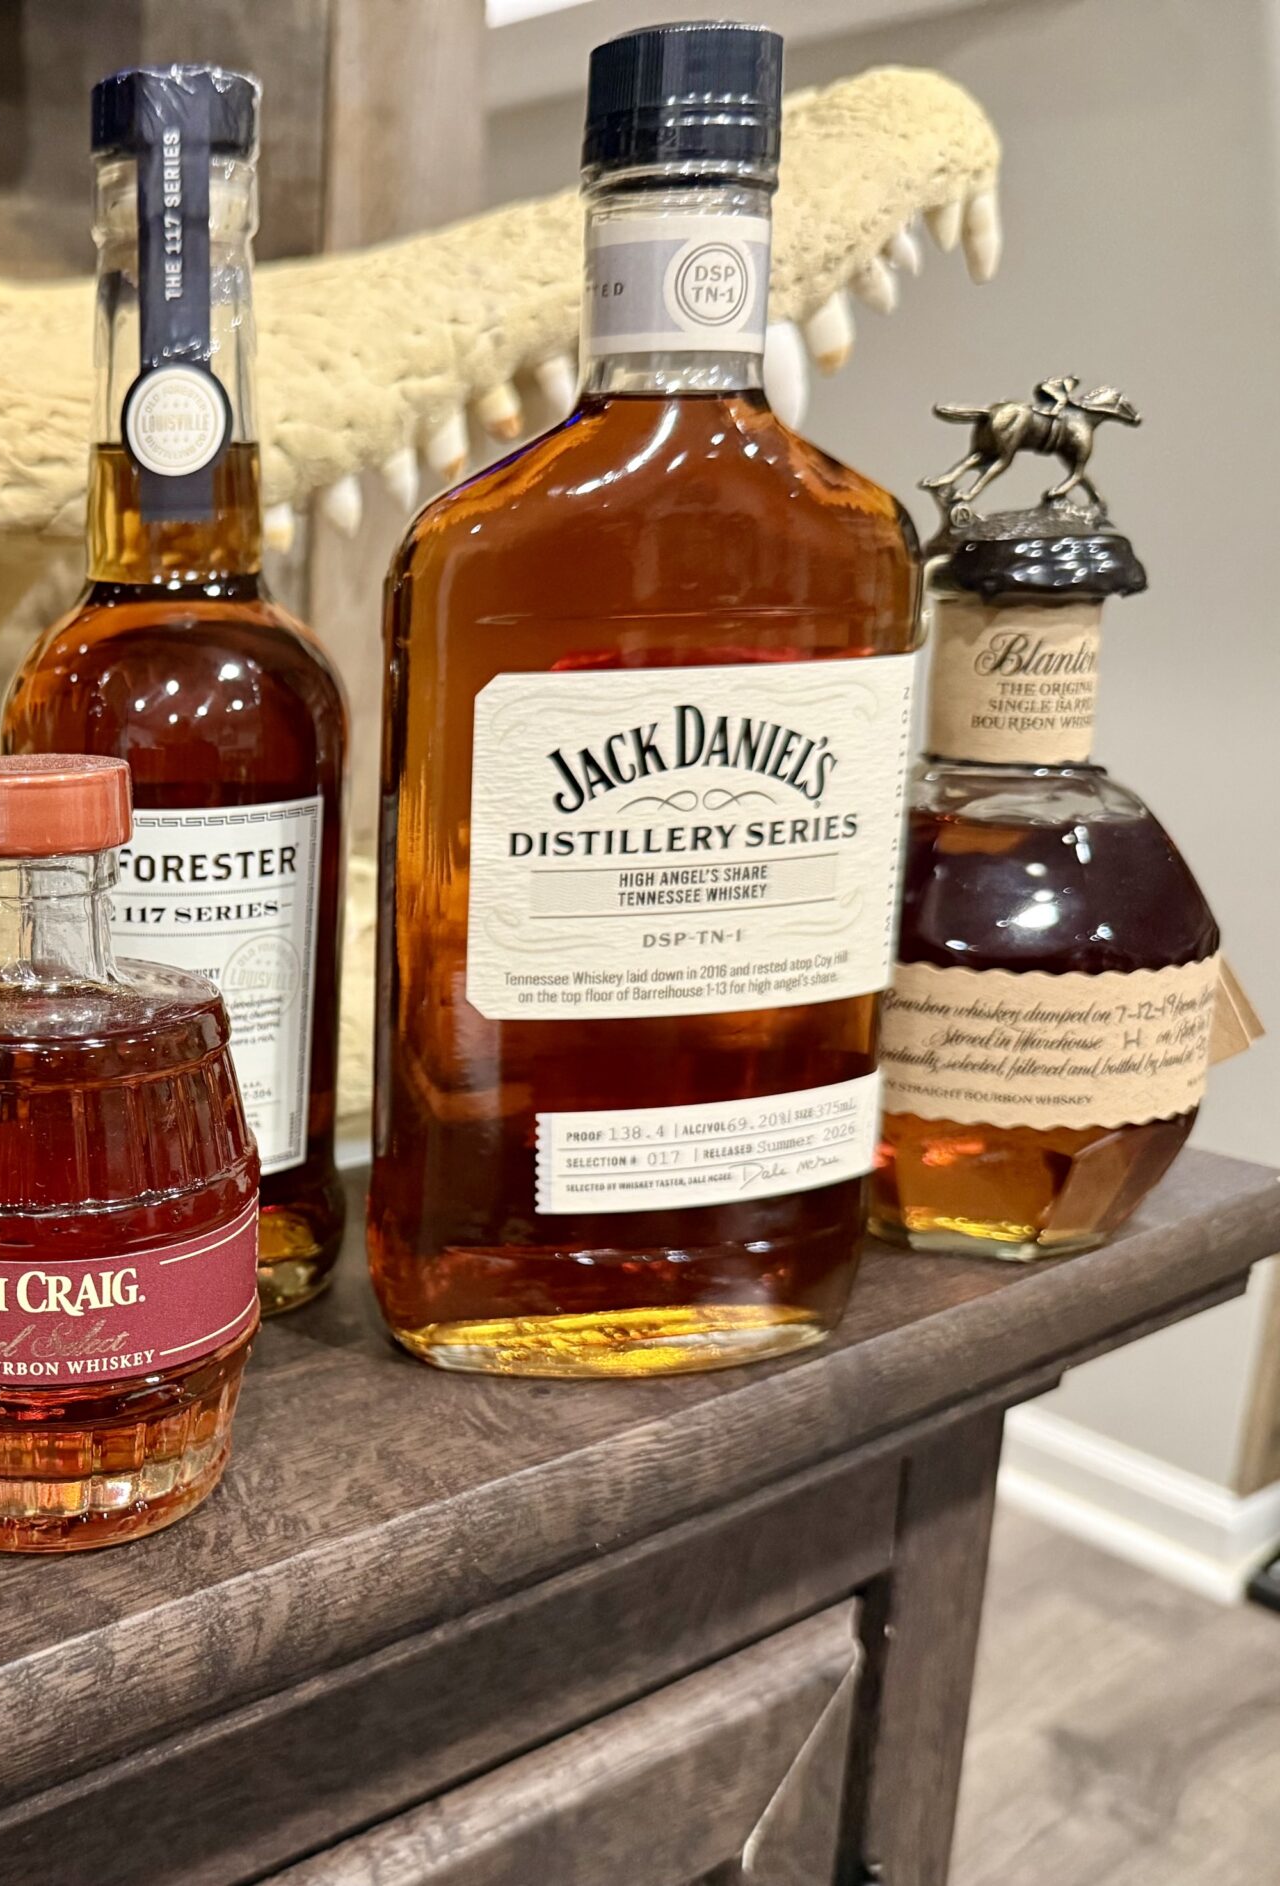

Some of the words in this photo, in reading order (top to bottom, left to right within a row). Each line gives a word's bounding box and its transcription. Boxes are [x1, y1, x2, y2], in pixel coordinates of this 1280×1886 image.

[162, 126, 182, 208] SERIES
[163, 208, 183, 255] 117
[165, 257, 184, 302] THE
[694, 265, 736, 282] DSP
[691, 286, 735, 304] TN-1
[998, 682, 1036, 696] THE
[988, 699, 1051, 714] SINGLE
[971, 715, 1056, 731] BOURBON
[546, 722, 669, 815] JACK
[673, 704, 839, 801] DANIEL'S
[508, 823, 737, 859] DISTILLERY
[744, 812, 858, 848] SERIES
[619, 872, 655, 888] HIGH
[659, 868, 719, 886] ANGEL'S
[723, 864, 768, 882] SHARE
[617, 887, 702, 907] TENNESSEE
[706, 883, 768, 902] WHISKEY
[124, 906, 166, 923] 117
[174, 899, 280, 924] SERIES
[504, 971, 569, 986] Tennessee
[572, 969, 623, 988] Whiskey
[626, 968, 648, 984] laid
[650, 967, 683, 983] down
[686, 965, 697, 981] in
[700, 964, 728, 980] 2016
[729, 962, 750, 977] and
[752, 957, 788, 974] rested
[789, 956, 813, 972] atop
[814, 953, 833, 969] Coy
[834, 949, 849, 965] Hill
[518, 991, 533, 1003] on
[537, 989, 558, 1003] the
[562, 989, 582, 1006] top
[585, 987, 614, 1003] floor
[616, 986, 630, 1001] of
[632, 984, 703, 1001] Barrelhouse
[706, 981, 727, 996] 1-13
[729, 979, 745, 994] for
[748, 978, 771, 995] high
[773, 973, 809, 992] angel's
[953, 998, 1023, 1026] whiskey
[1022, 1001, 1096, 1029] dumped
[1091, 1010, 1112, 1025] on
[922, 1023, 995, 1049] Stored
[996, 1029, 1013, 1049] in
[1012, 1026, 1104, 1053] Warehouse
[1123, 1027, 1142, 1050] H
[1067, 1057, 1102, 1079] and
[1101, 1052, 1145, 1076] bottled
[1144, 1052, 1158, 1077] by
[899, 1083, 964, 1099] STRAIGHT
[964, 1089, 1033, 1105] BOURBON
[1035, 1093, 1094, 1106] WHISKEY
[566, 1131, 603, 1142] PROOF
[608, 1124, 665, 1141] 138.4
[682, 1121, 727, 1137] ALC/VOL
[795, 1107, 814, 1121] SIZE
[566, 1156, 627, 1168] SELECTION
[647, 1150, 681, 1166] 017
[703, 1145, 753, 1159] RELEASED
[757, 1133, 816, 1154] Summer
[823, 1122, 856, 1142] 2026
[566, 1184, 606, 1192] SELECTED
[619, 1180, 654, 1190] WHISKEY
[31, 1319, 131, 1359] Select
[66, 1349, 156, 1375] WHISKEY
